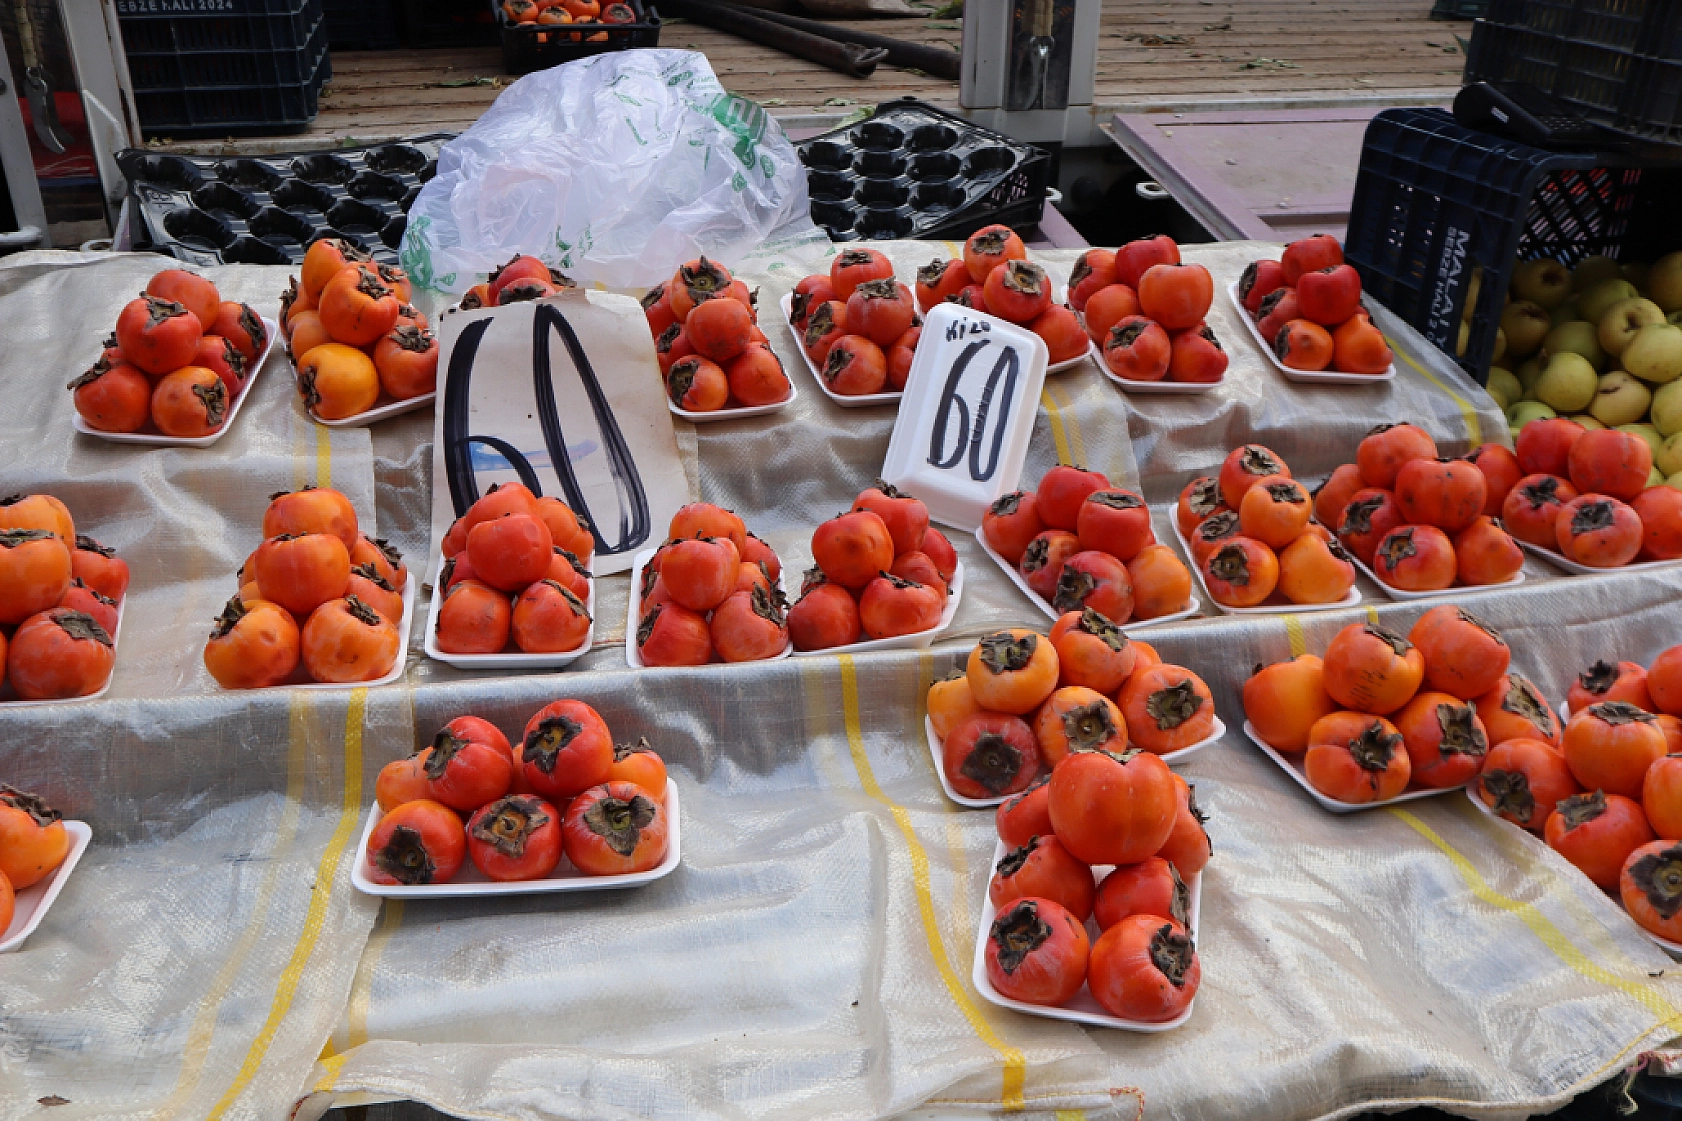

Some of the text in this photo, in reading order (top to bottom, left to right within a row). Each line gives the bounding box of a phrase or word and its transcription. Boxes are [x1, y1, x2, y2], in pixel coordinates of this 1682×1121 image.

[198, 0, 233, 11] 2024
[443, 304, 650, 555] 60
[926, 339, 1020, 482] 60
